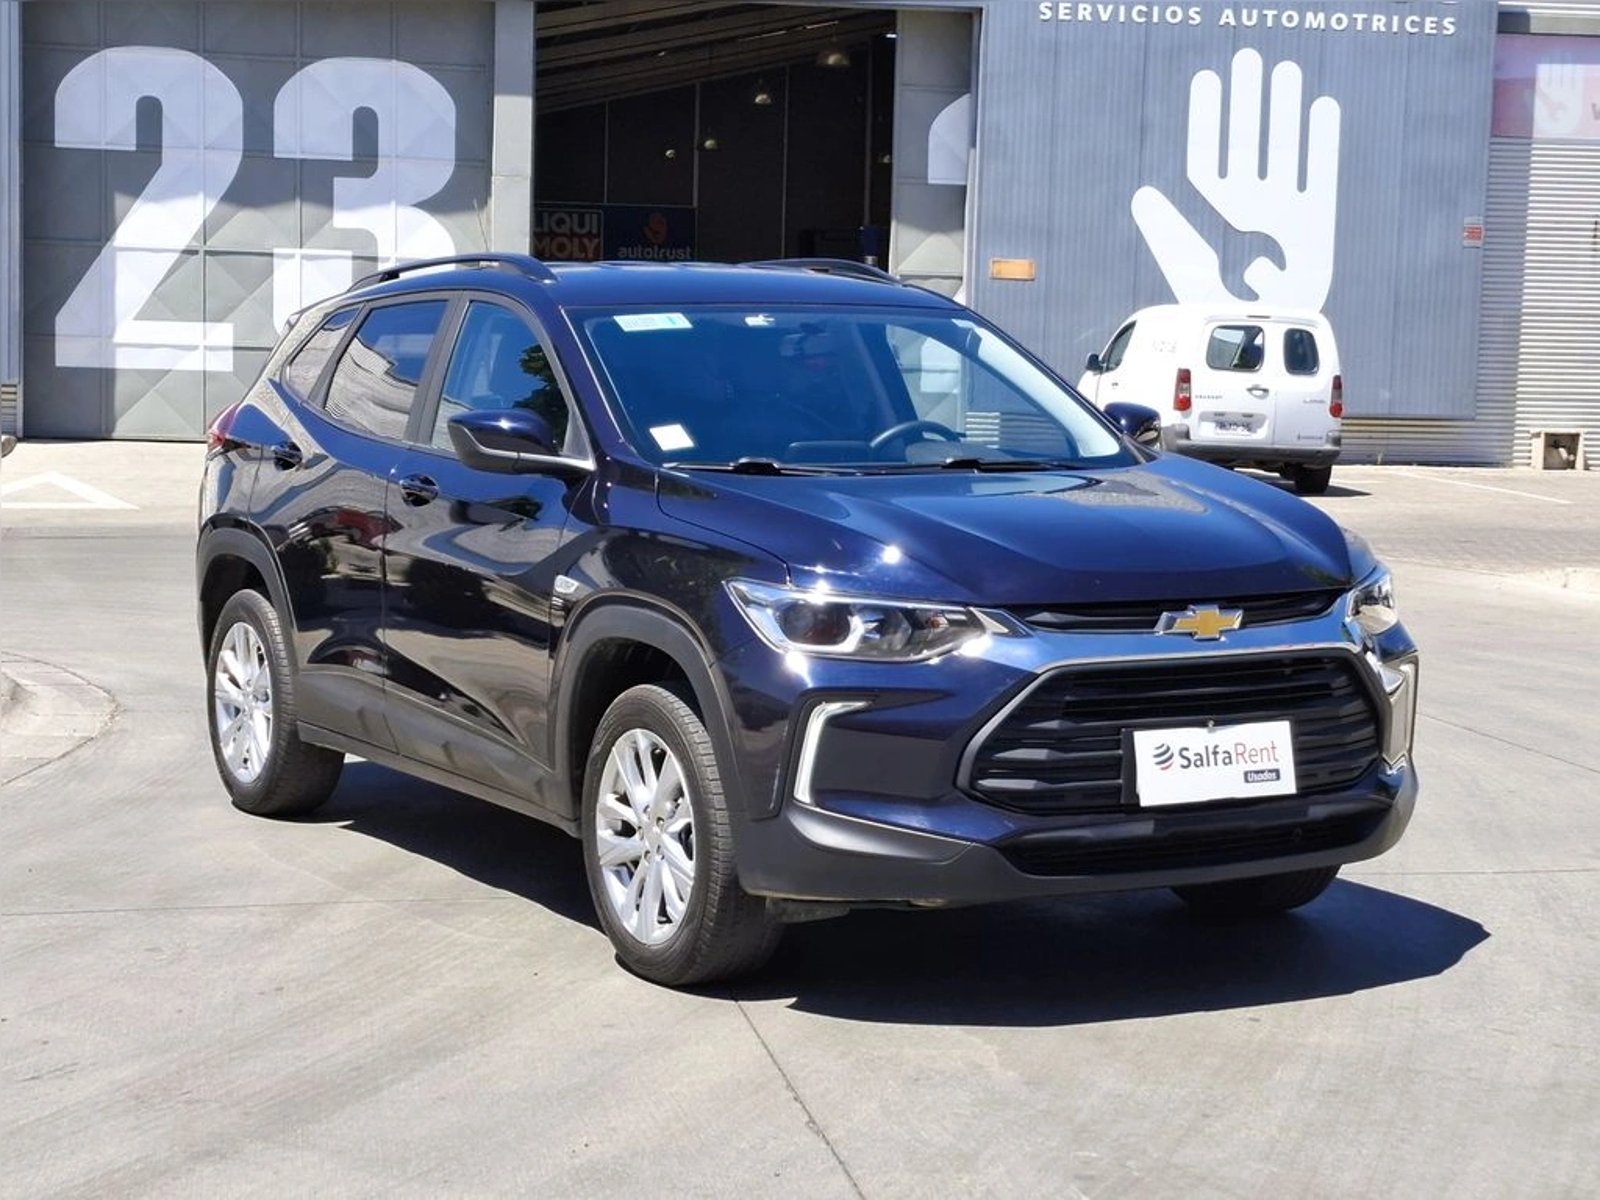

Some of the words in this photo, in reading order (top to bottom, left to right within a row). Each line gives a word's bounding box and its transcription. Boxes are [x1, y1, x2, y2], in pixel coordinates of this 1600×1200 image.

[1038, 2, 1202, 25] SERVICIOS
[1218, 8, 1457, 36] AUTOMOTRICES
[54, 45, 457, 371] 23
[532, 236, 600, 259] MOLY
[617, 244, 692, 259] autotrust
[1178, 740, 1279, 769] SalfaRent
